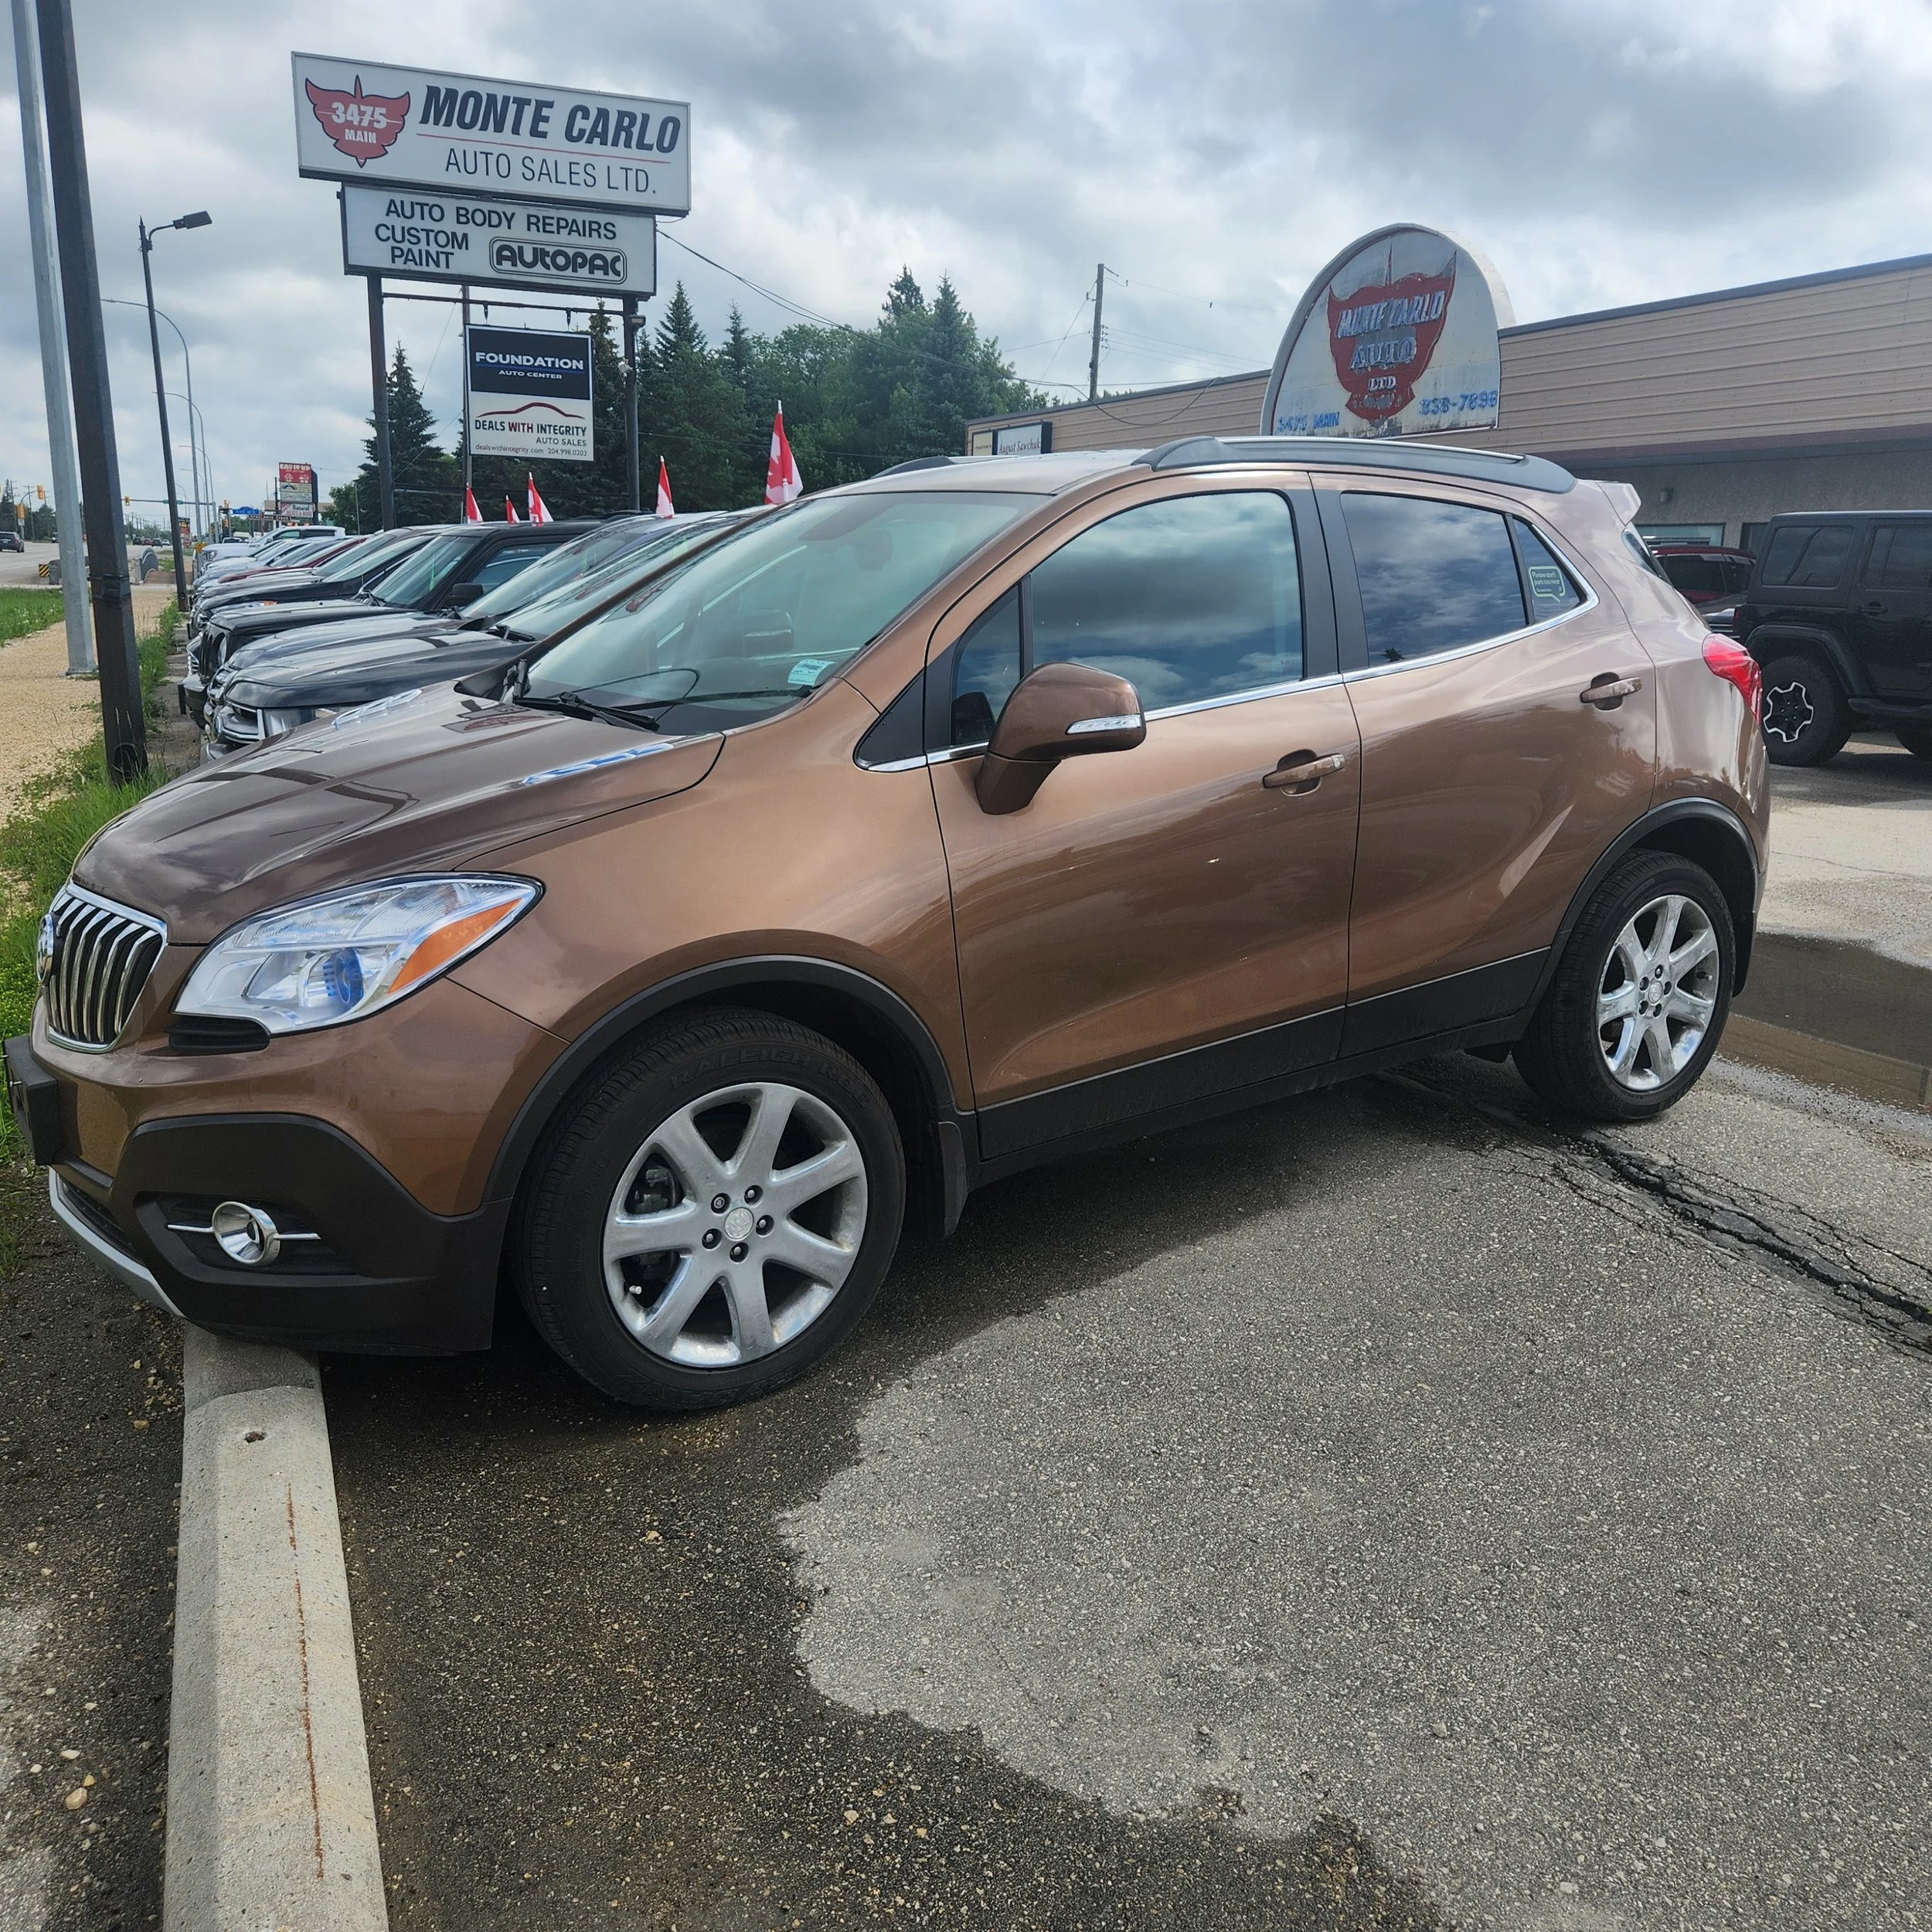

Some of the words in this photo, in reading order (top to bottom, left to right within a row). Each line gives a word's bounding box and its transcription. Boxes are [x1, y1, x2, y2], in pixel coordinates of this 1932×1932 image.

[332, 101, 386, 129] 3475
[418, 84, 555, 139] MONTE
[564, 104, 682, 154] CARLO
[344, 128, 377, 145] MAIN
[445, 148, 512, 179] AUTO
[522, 156, 597, 188] SALES
[607, 165, 656, 194] LTD.
[386, 199, 445, 223] AUTO
[456, 206, 515, 230] BODY
[526, 213, 617, 240] REPAIRS
[375, 223, 469, 251] CUSTOM
[390, 245, 454, 270] PAINT
[1335, 301, 1389, 338] MONTE
[1387, 291, 1445, 328] CARLO
[475, 352, 584, 370] FOUNDATION
[1348, 336, 1417, 369] AUTO
[475, 420, 505, 431] DEALS
[509, 421, 534, 434] WITH
[536, 423, 587, 437] INTEGRITY
[475, 444, 544, 454] dealswithintegrity.com
[547, 447, 587, 456] 204.998.0203
[536, 437, 560, 445] AUTO
[562, 438, 587, 447] SALES
[998, 441, 1016, 454] August
